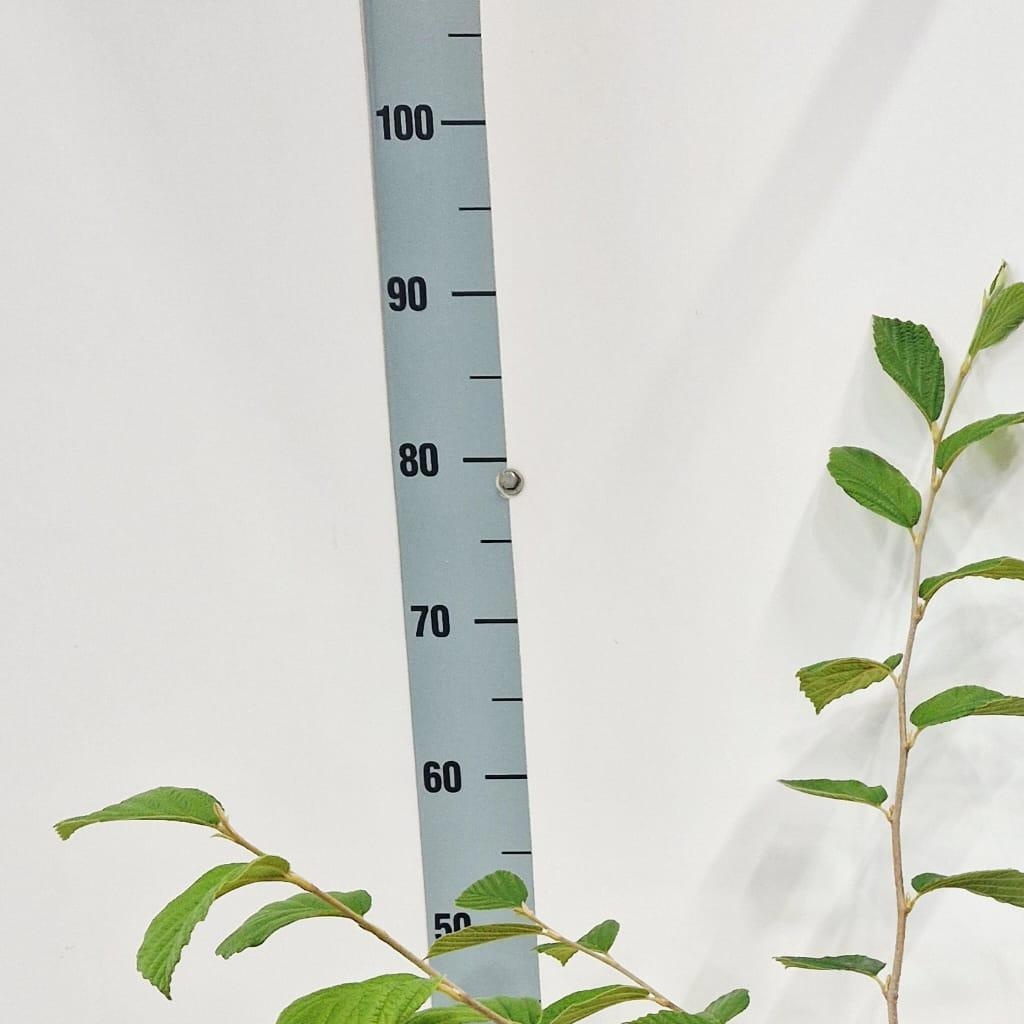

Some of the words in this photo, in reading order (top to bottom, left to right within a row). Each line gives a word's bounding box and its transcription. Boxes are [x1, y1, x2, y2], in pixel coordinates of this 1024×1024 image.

[375, 104, 435, 141] 100
[386, 276, 428, 312] 90
[398, 442, 439, 478] 80
[410, 604, 451, 638] 70
[423, 760, 462, 793] 60
